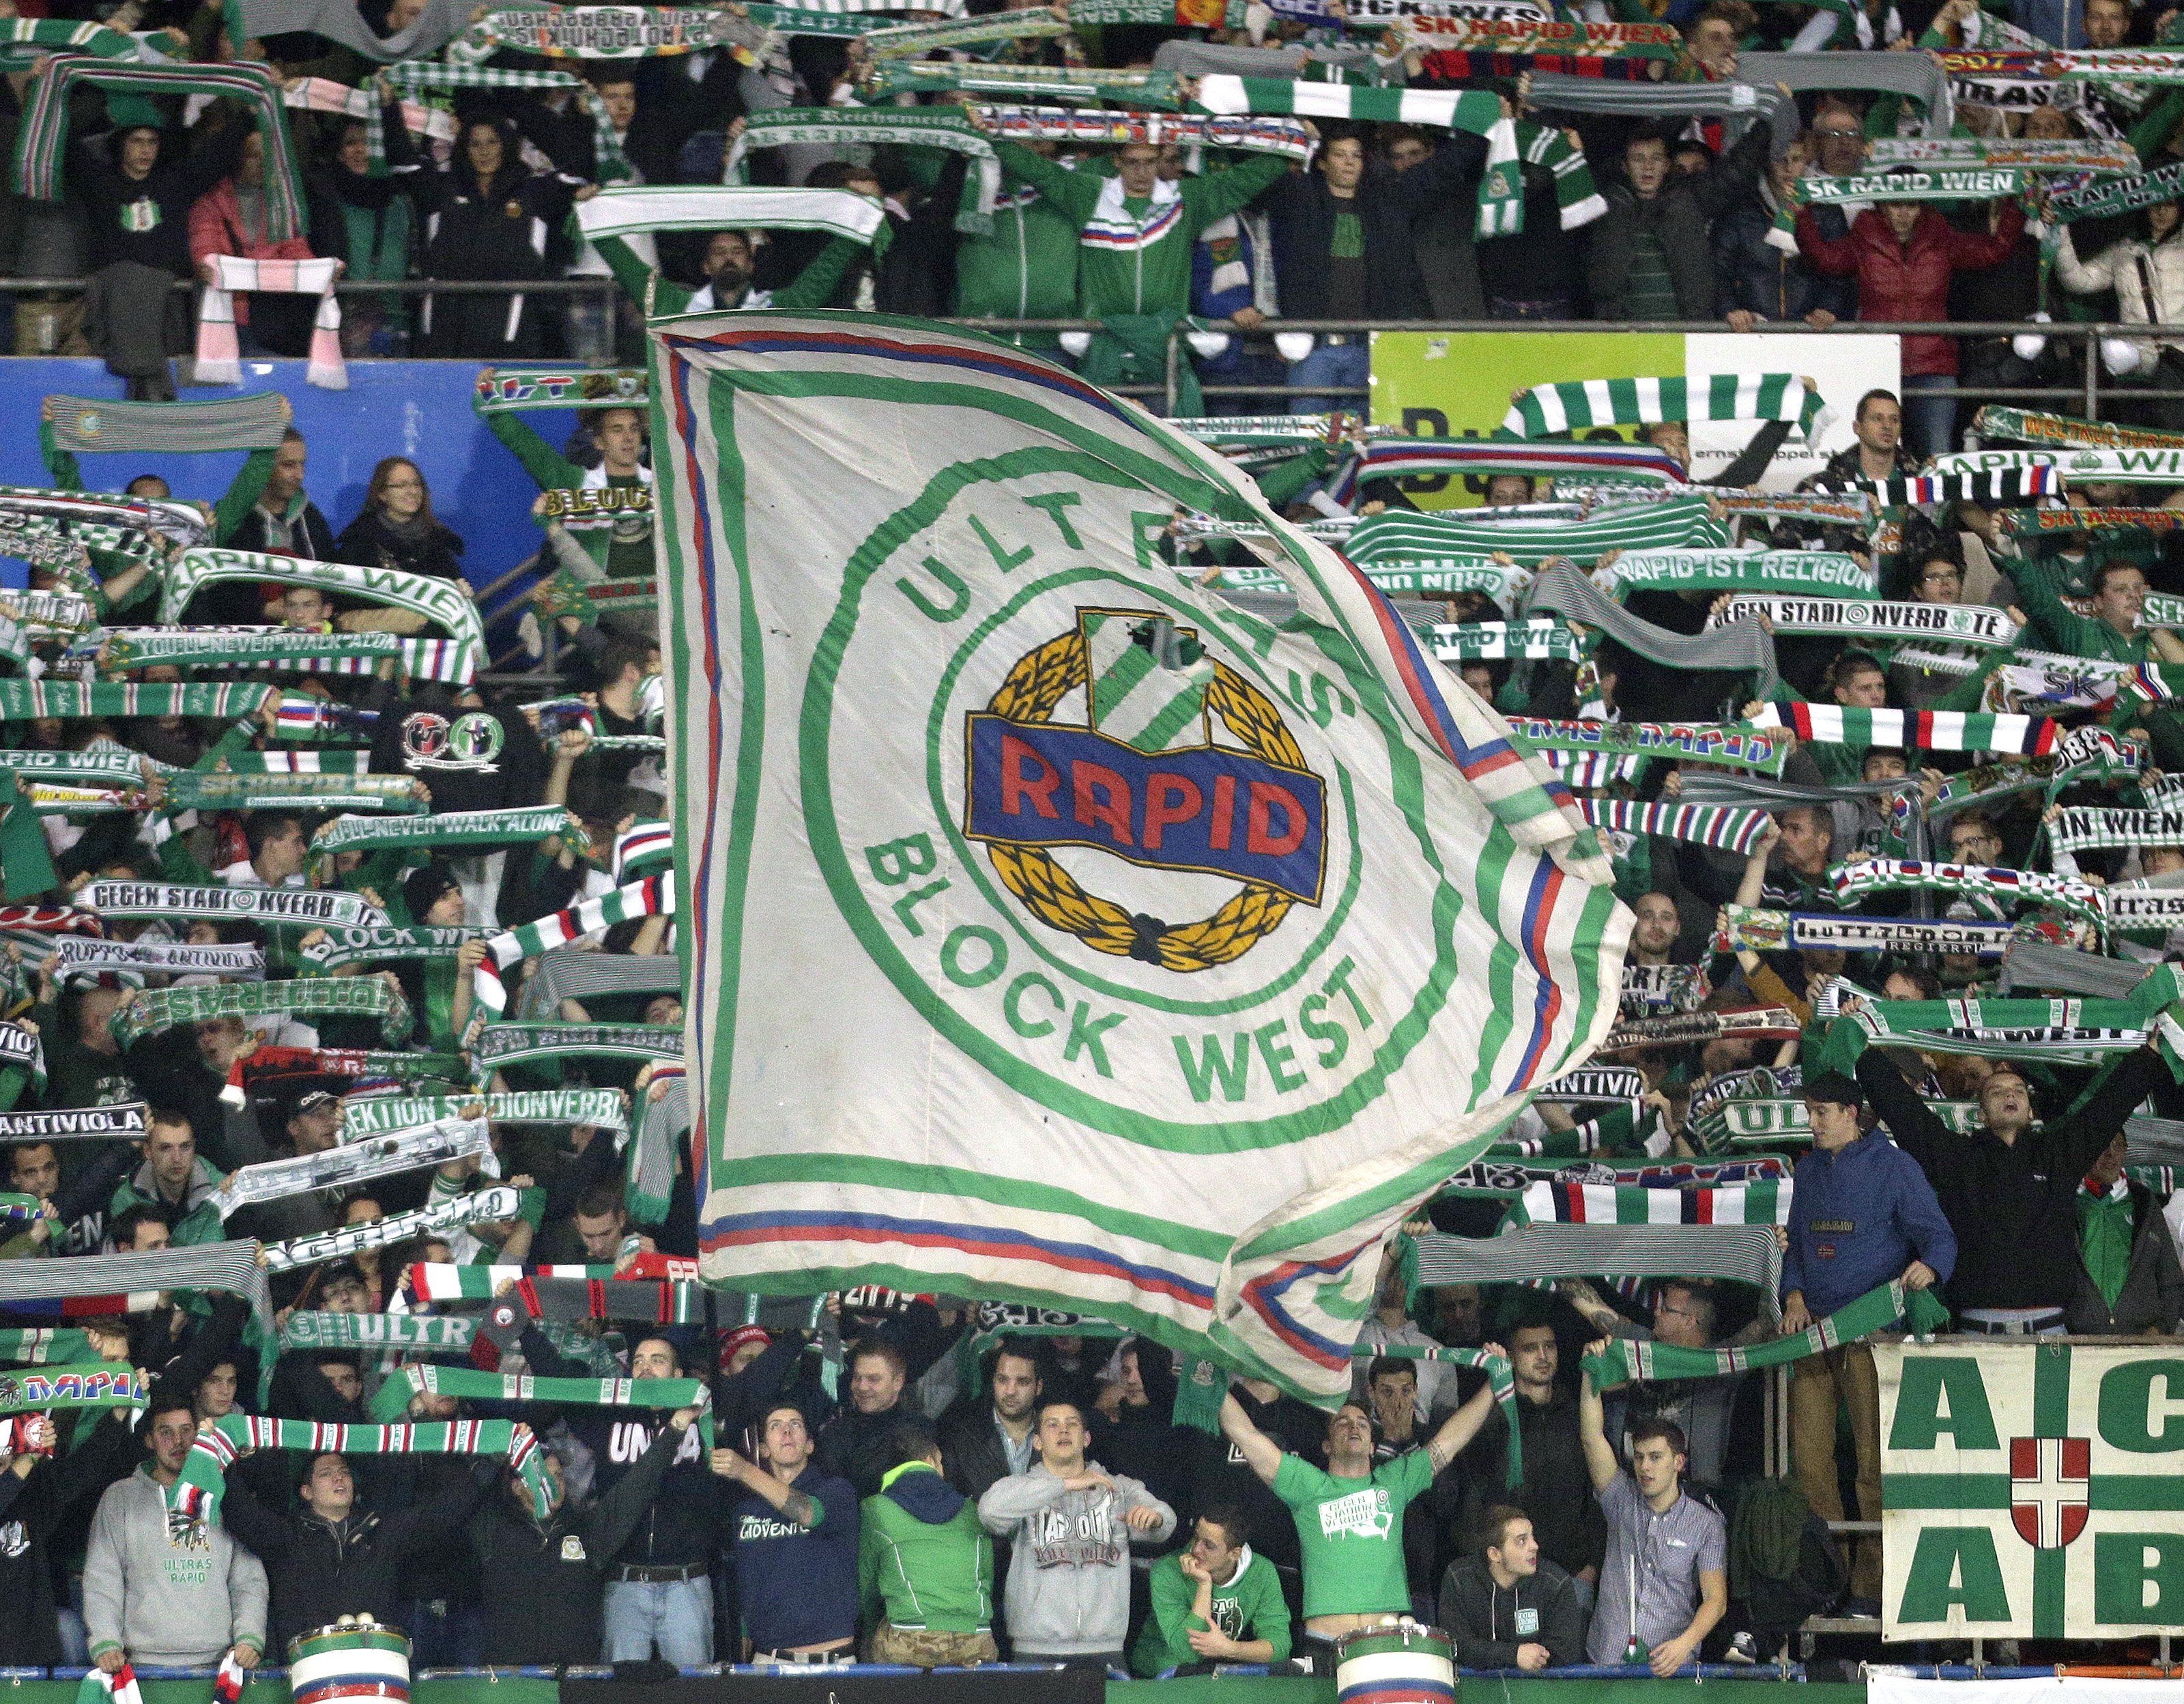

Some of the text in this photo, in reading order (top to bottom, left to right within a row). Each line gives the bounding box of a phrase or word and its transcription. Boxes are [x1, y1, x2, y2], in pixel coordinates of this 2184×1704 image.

[1413, 15, 1459, 35] SK
[1469, 18, 1575, 40] RAPID
[1585, 22, 1671, 45] WIEN
[1805, 171, 2013, 199] SK RAPID WIEN
[547, 487, 652, 516] BLOC
[1368, 573, 1413, 589] UN
[1613, 554, 1873, 593] RAPID IST RELIGION
[350, 633, 397, 649] ALON
[1426, 629, 1496, 648] APID
[1637, 722, 1773, 763] RAPID
[68, 752, 143, 773] WIEN
[1000, 734, 1309, 858] RAPID
[444, 815, 500, 833] WALK
[505, 813, 567, 832] ALONE
[2058, 811, 2183, 839] IN WIEN
[94, 885, 160, 907] GEGEN
[303, 928, 505, 963] BLOCK WES
[863, 831, 1375, 1103] BLOCK WEST
[166, 980, 379, 1019] ULTRAS
[0, 1110, 144, 1135] ANTIVIOLA
[163, 1558, 212, 1570] ULTRAS
[170, 1572, 206, 1584] RAPID
